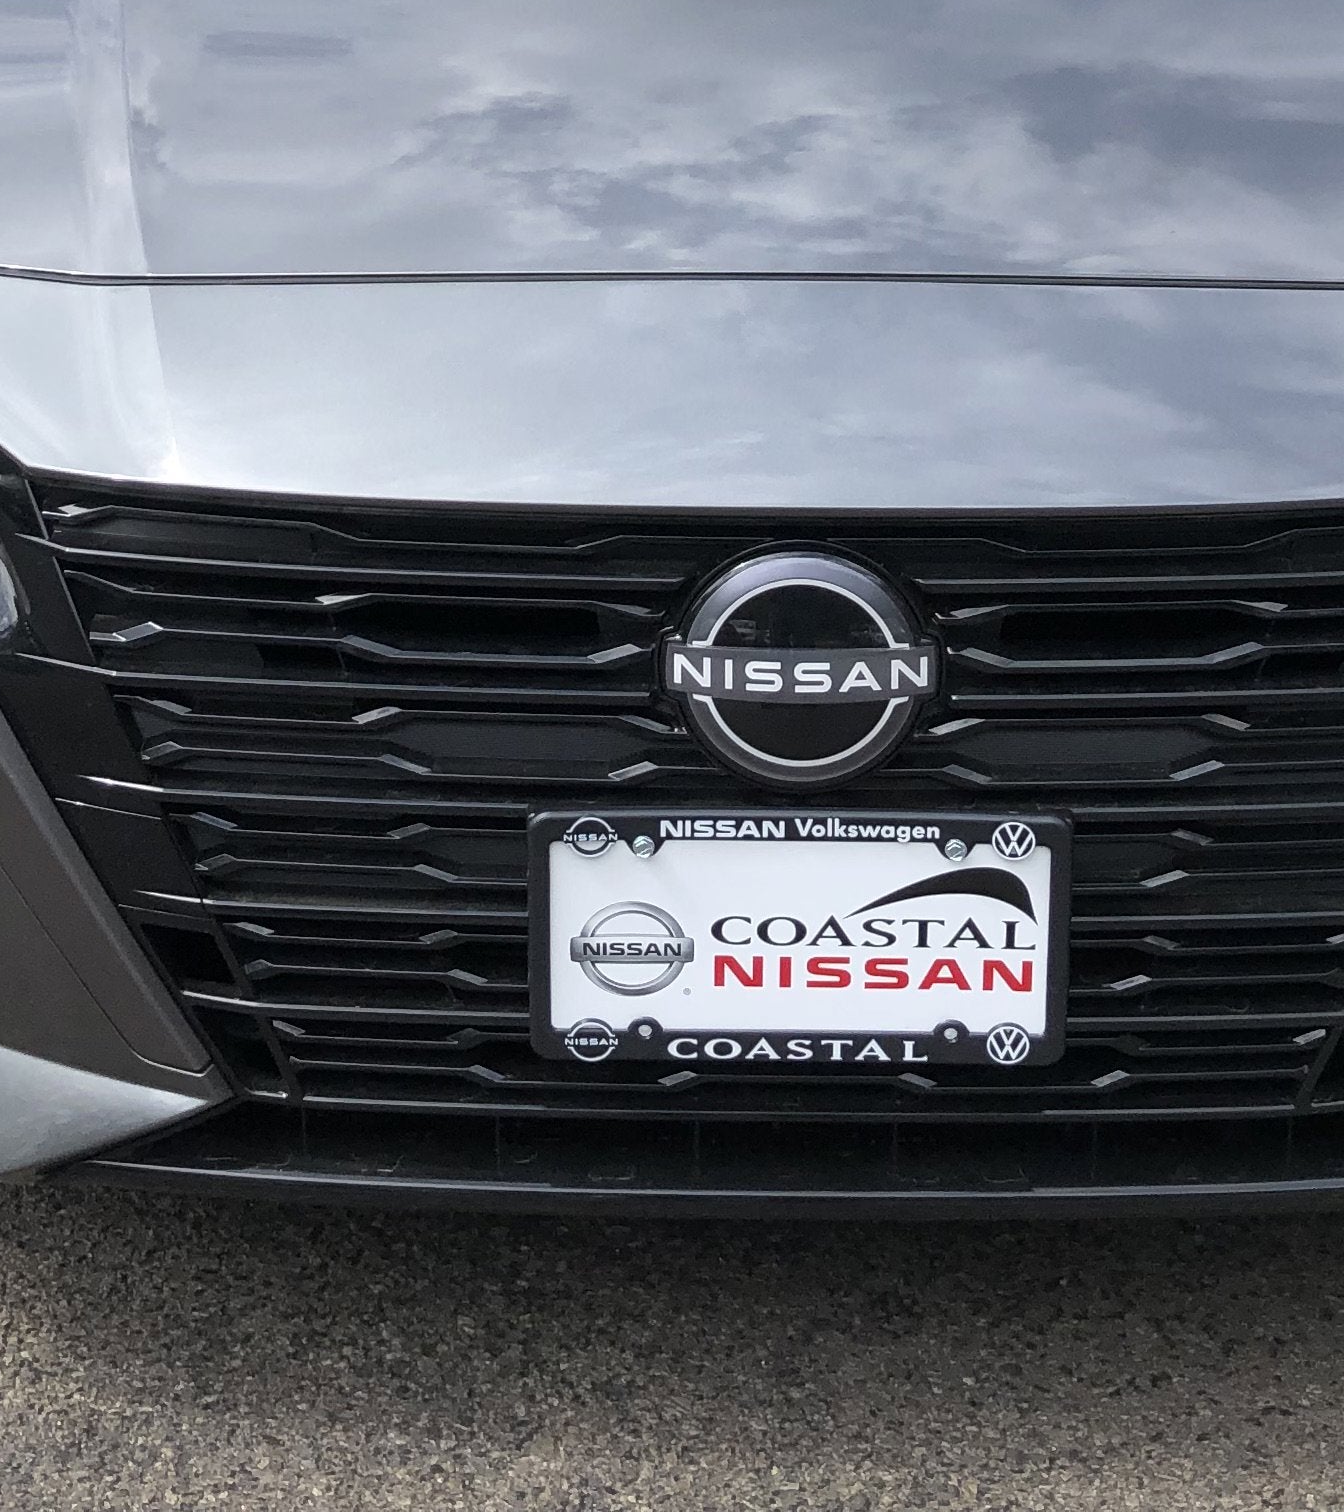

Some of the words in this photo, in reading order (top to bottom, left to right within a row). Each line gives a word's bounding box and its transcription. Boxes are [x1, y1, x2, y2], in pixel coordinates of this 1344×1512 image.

[673, 652, 928, 693] NISSAN
[563, 833, 618, 842] NISSAN
[660, 819, 786, 839] NISSAN
[794, 818, 941, 840] Volkswagen
[710, 914, 1036, 949] COASTAL
[582, 942, 682, 957] NISSAN
[714, 956, 1033, 991] NISSAN
[564, 1038, 619, 1046] NISSAN
[667, 1038, 928, 1062] COASTAL
